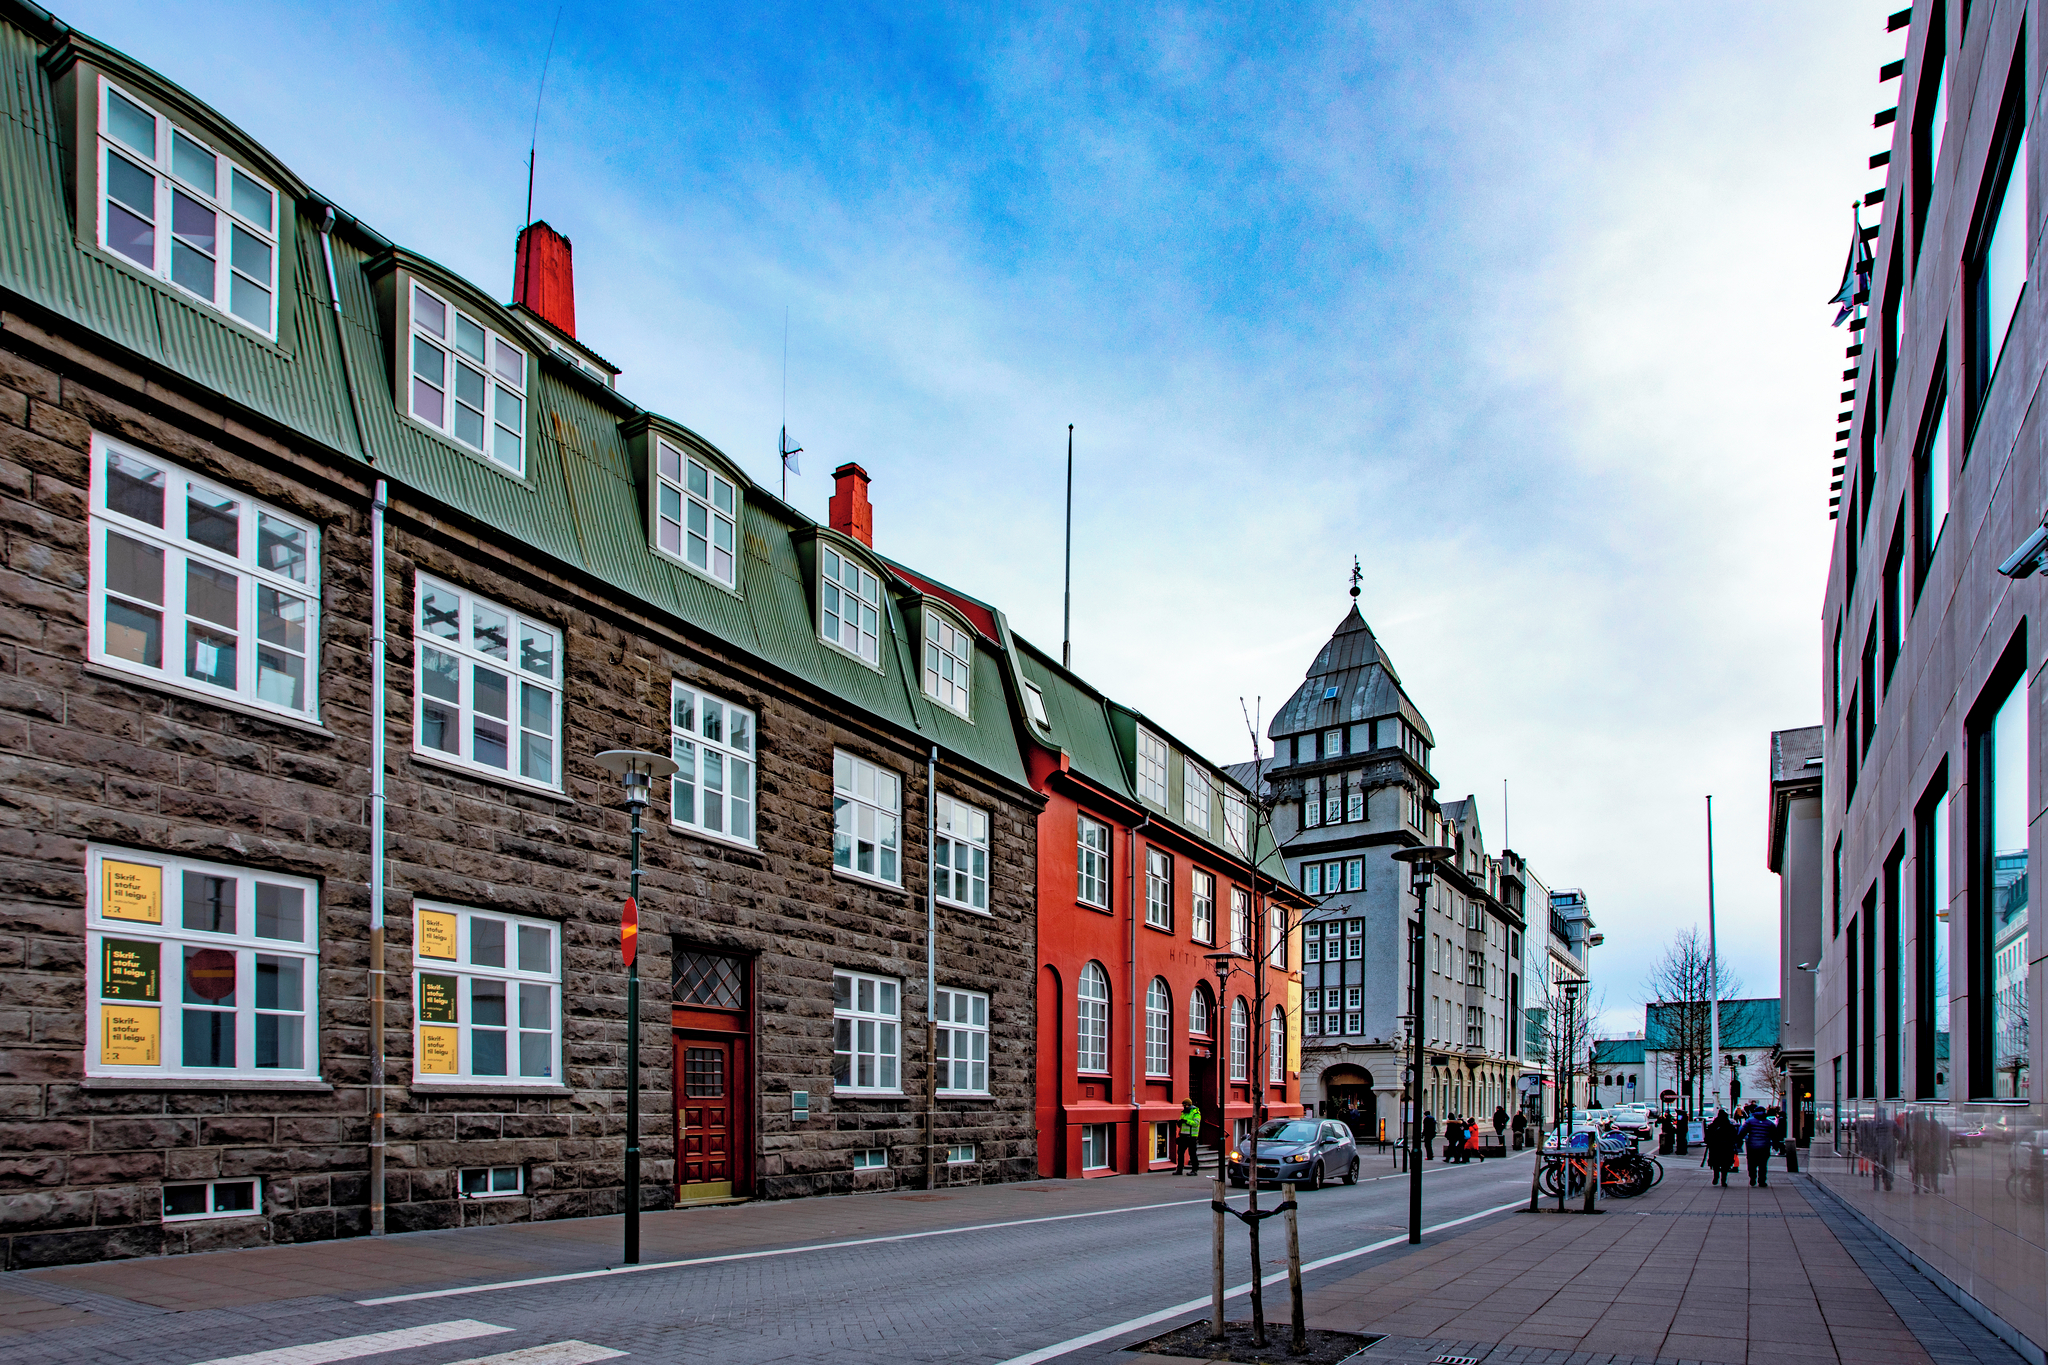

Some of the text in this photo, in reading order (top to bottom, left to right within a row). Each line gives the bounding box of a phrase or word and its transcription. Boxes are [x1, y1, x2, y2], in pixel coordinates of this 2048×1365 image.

[114, 872, 141, 882] Skrif-
[114, 882, 141, 890] stofur
[125, 890, 147, 900] leigu
[433, 933, 447, 941] leigu
[112, 960, 141, 968] stofur
[123, 967, 146, 978] leigu
[123, 1034, 146, 1043] leigu
